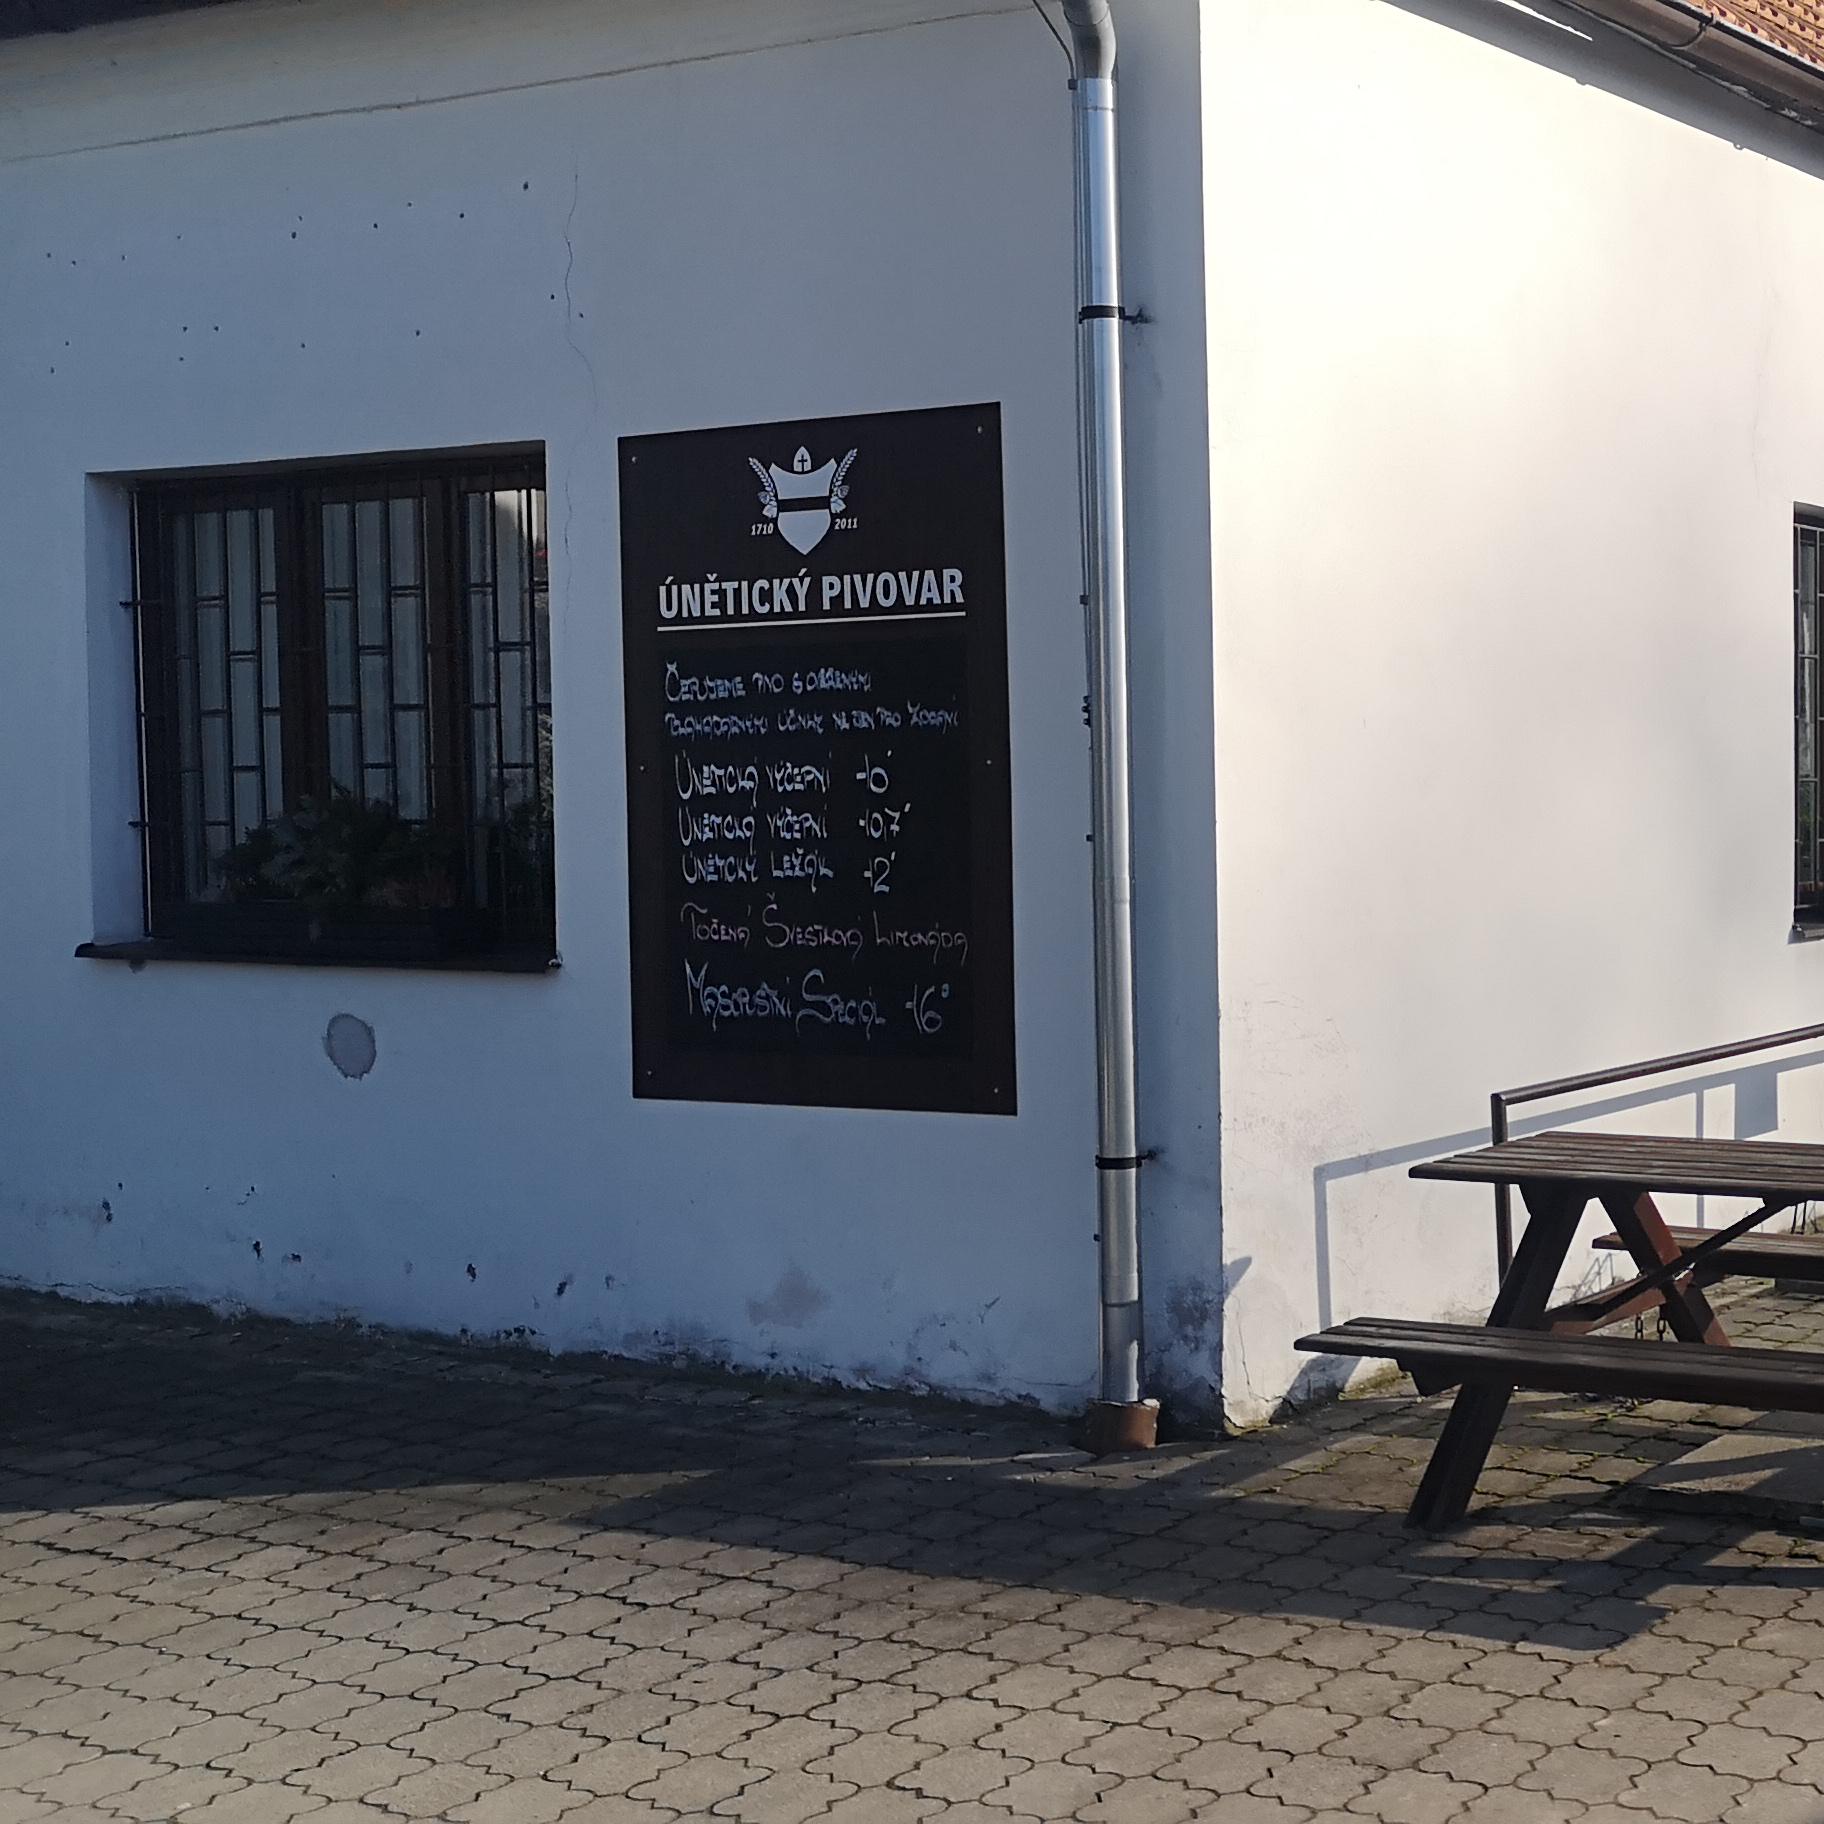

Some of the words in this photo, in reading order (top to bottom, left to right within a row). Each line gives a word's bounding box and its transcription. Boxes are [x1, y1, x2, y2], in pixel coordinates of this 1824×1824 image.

[751, 522, 774, 536] 1710
[834, 517, 859, 530] 2011
[658, 568, 811, 619] ÚNĚTICKÝ
[822, 568, 965, 611] PIVOVAR
